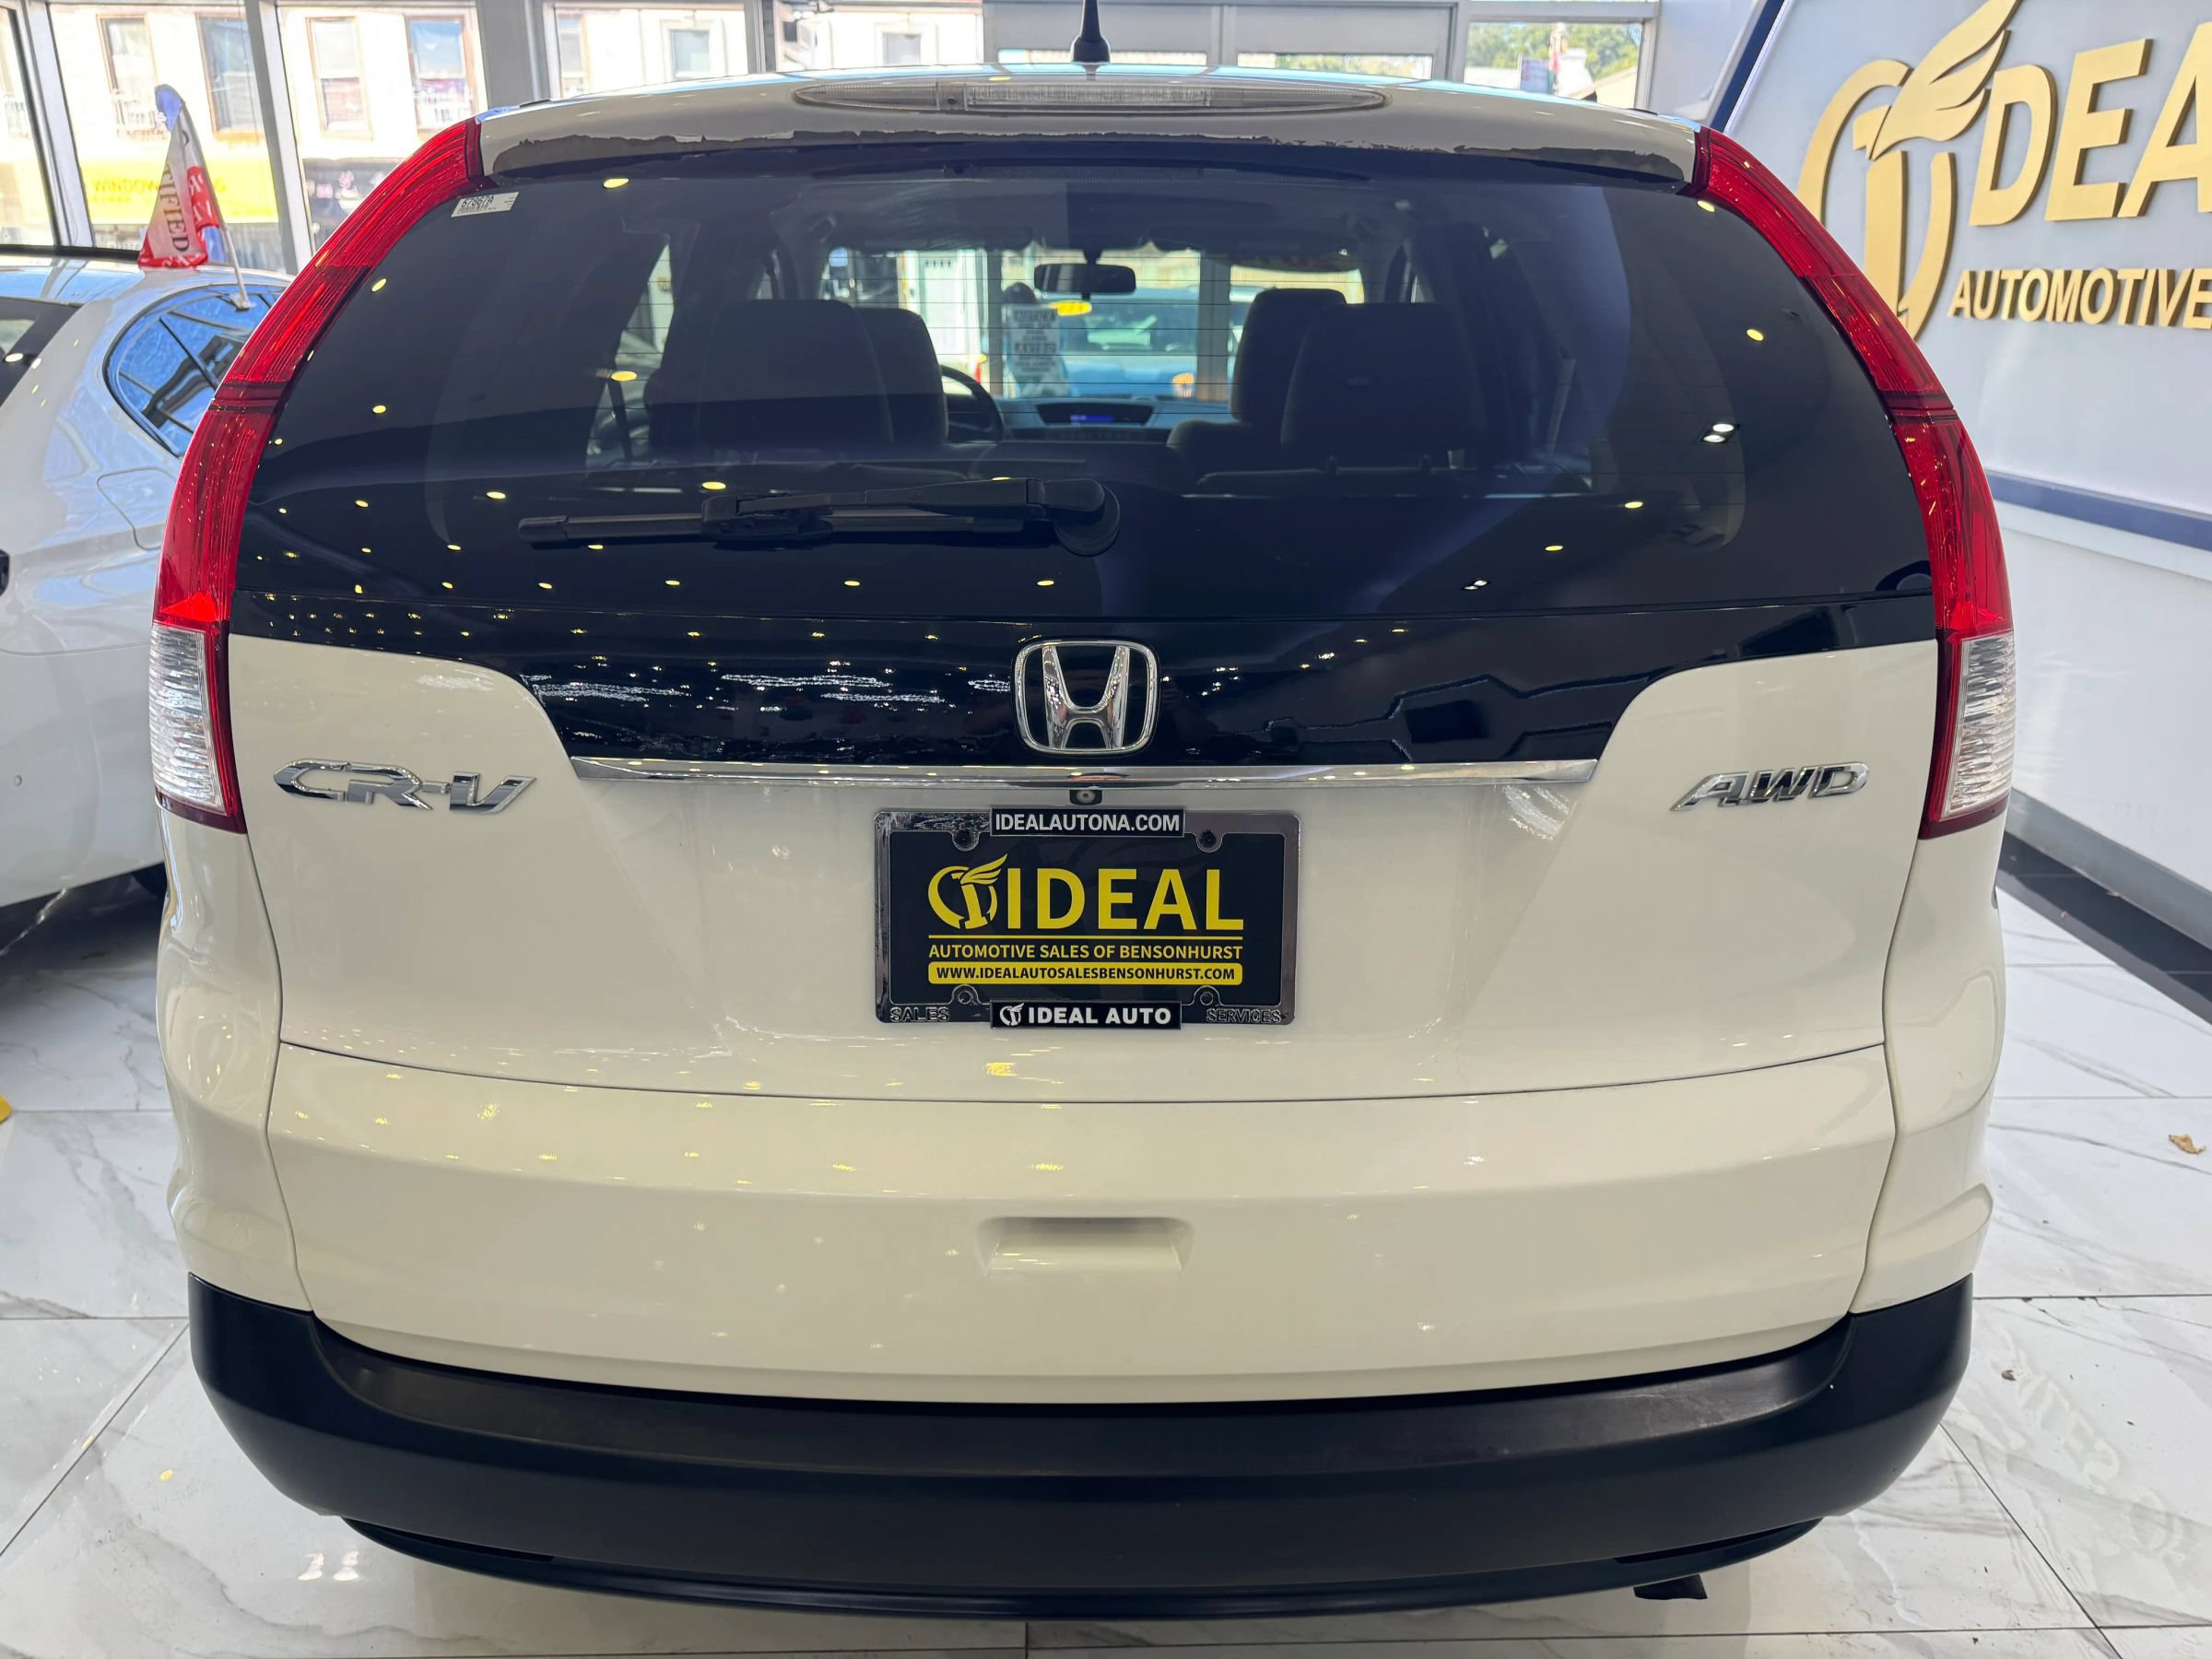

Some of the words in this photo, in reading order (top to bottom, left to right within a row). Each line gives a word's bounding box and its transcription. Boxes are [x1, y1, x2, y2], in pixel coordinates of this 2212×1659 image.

[1950, 267, 2212, 329] AUTOMOTIVE
[273, 759, 537, 814] CR-V
[1669, 761, 1869, 811] AWD
[994, 813, 1181, 831] IDEALAUTONA.COM
[1007, 867, 1244, 930] IDEAL
[928, 944, 1035, 959] AUTOMOTIVE
[1040, 944, 1089, 959] SALES
[1093, 945, 1116, 959] OF
[1119, 945, 1242, 959] BENSONHURST
[935, 967, 1236, 980] WWW.IDEALAUTOSALESBENSONHURST.COM
[889, 1006, 950, 1023] SALES
[1028, 1006, 1099, 1024] IDEAL
[1105, 1007, 1171, 1025] AUTO
[1206, 1007, 1283, 1024] SERVICES
